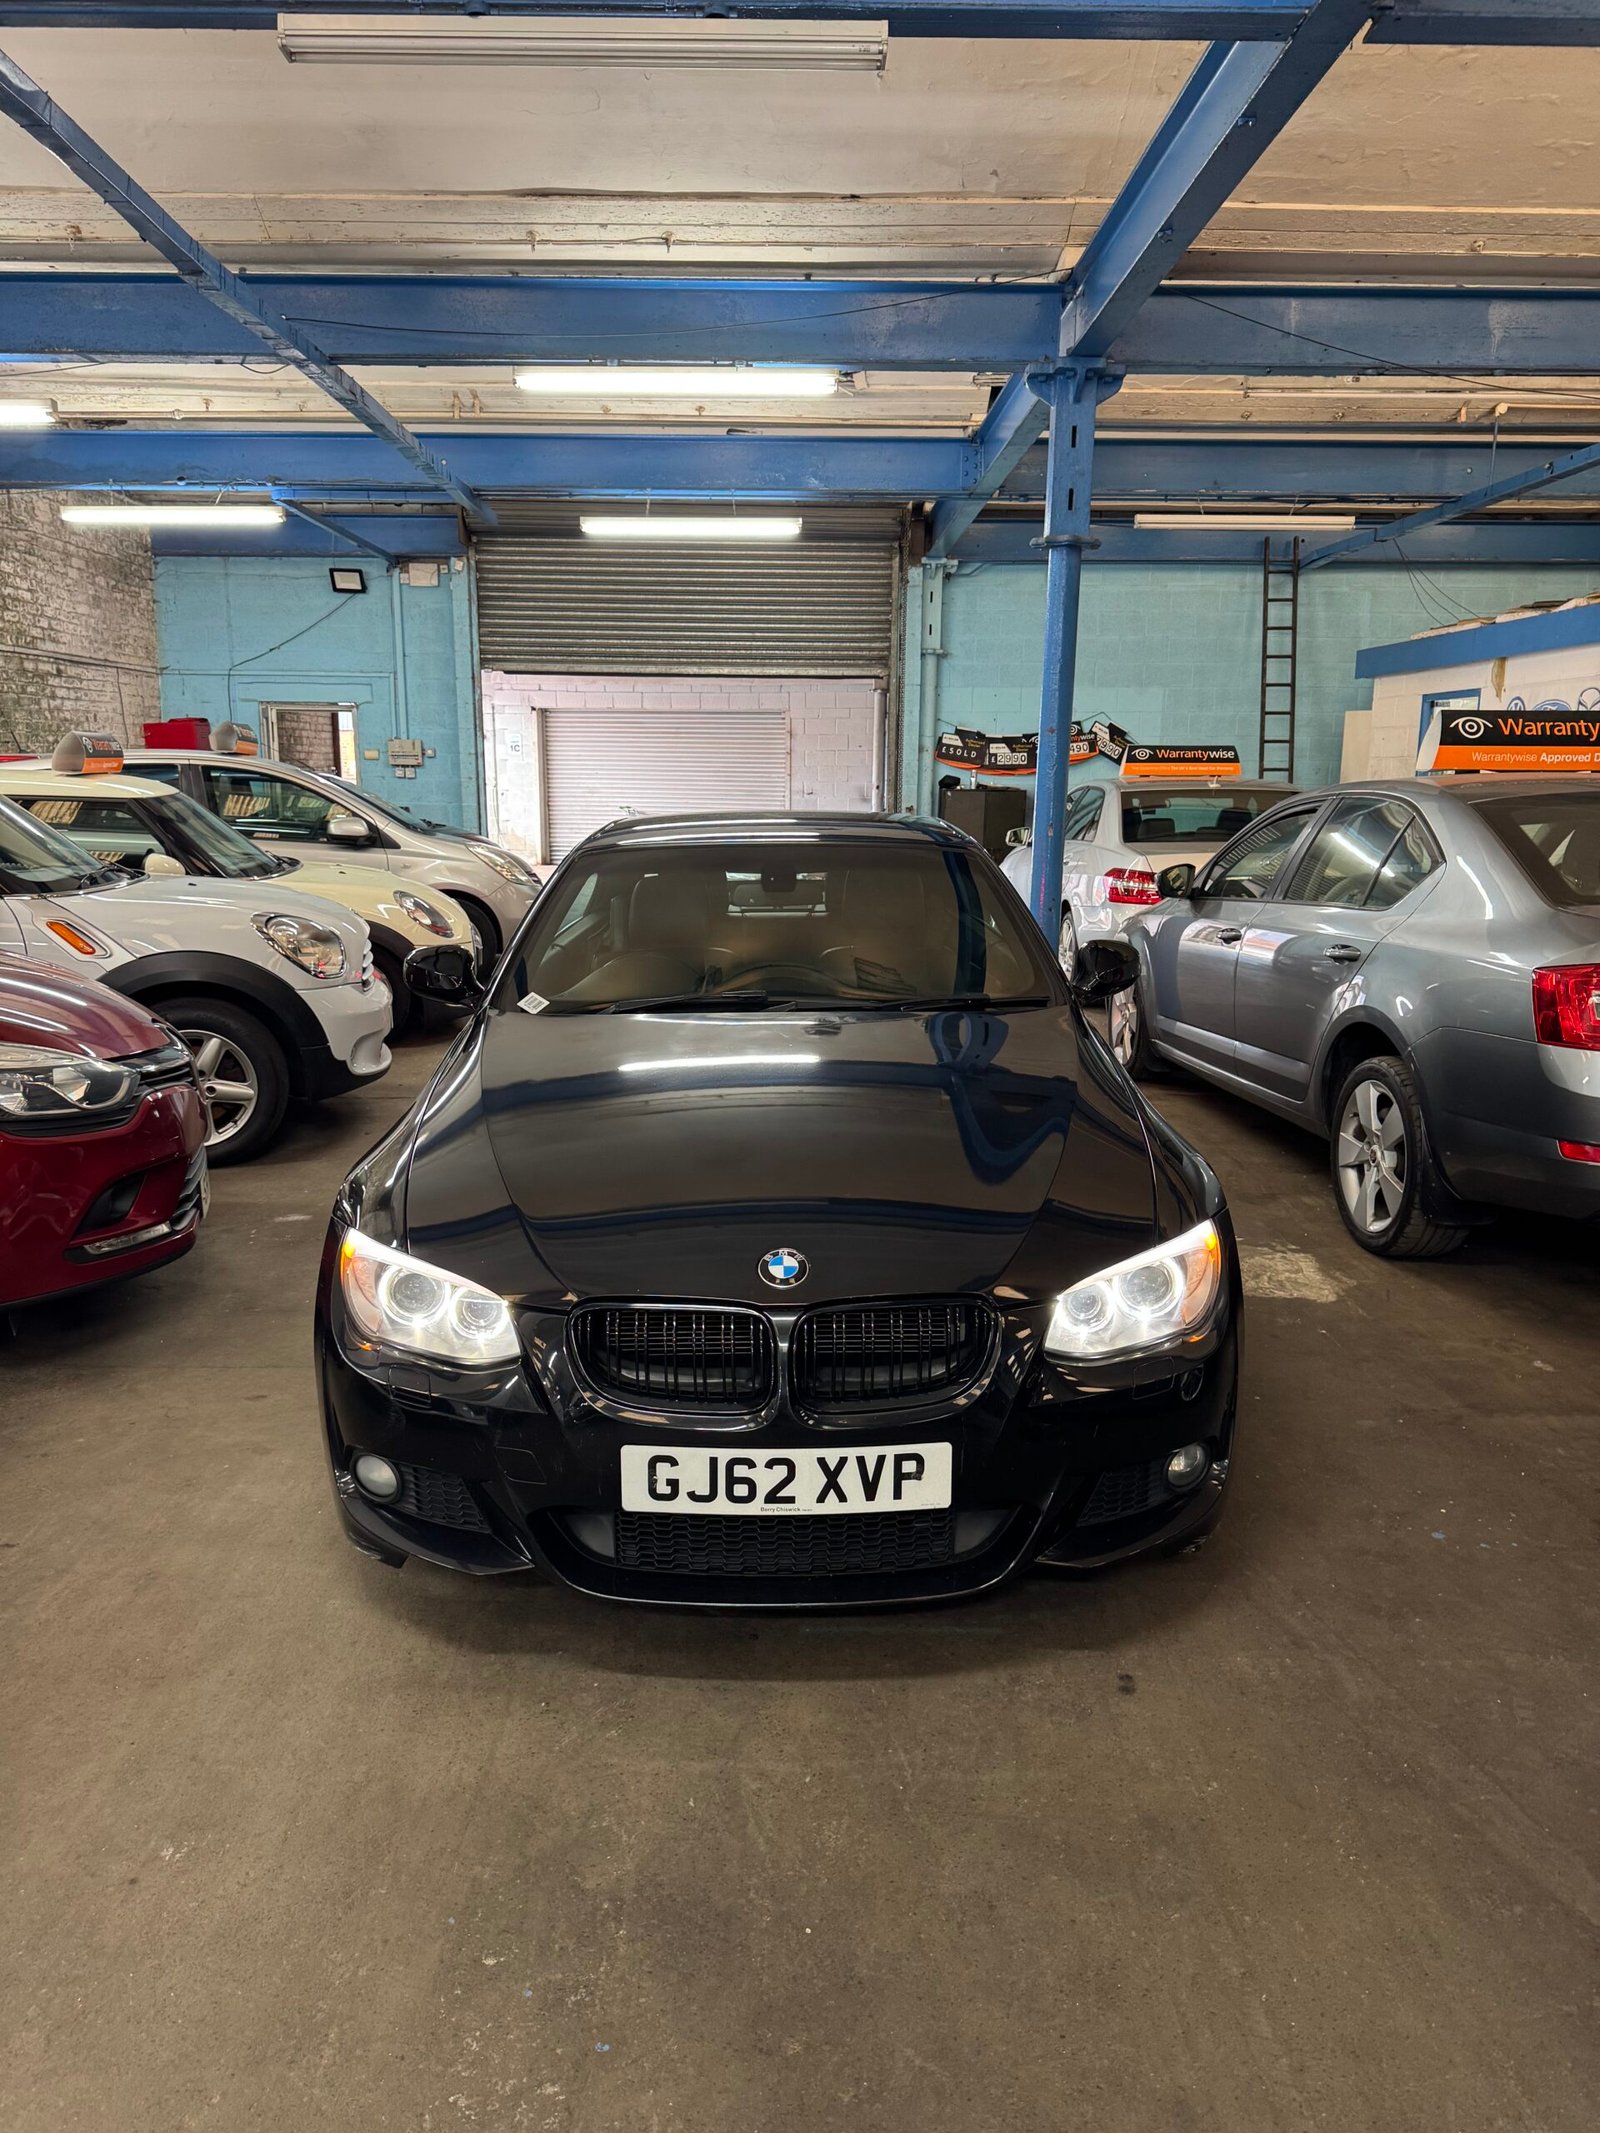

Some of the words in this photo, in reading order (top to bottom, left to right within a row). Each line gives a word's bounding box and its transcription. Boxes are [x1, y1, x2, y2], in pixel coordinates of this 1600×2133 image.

[1498, 718, 1600, 741] Warranty
[1071, 734, 1095, 742] ntywise
[1070, 743, 1088, 753] 490
[1156, 749, 1234, 760] Warrantywise
[1472, 752, 1537, 763] Warrantywise
[1540, 752, 1591, 763] Approved
[763, 1250, 803, 1261] BMW
[648, 1455, 796, 1504] GJ62
[816, 1453, 925, 1503] XVP
